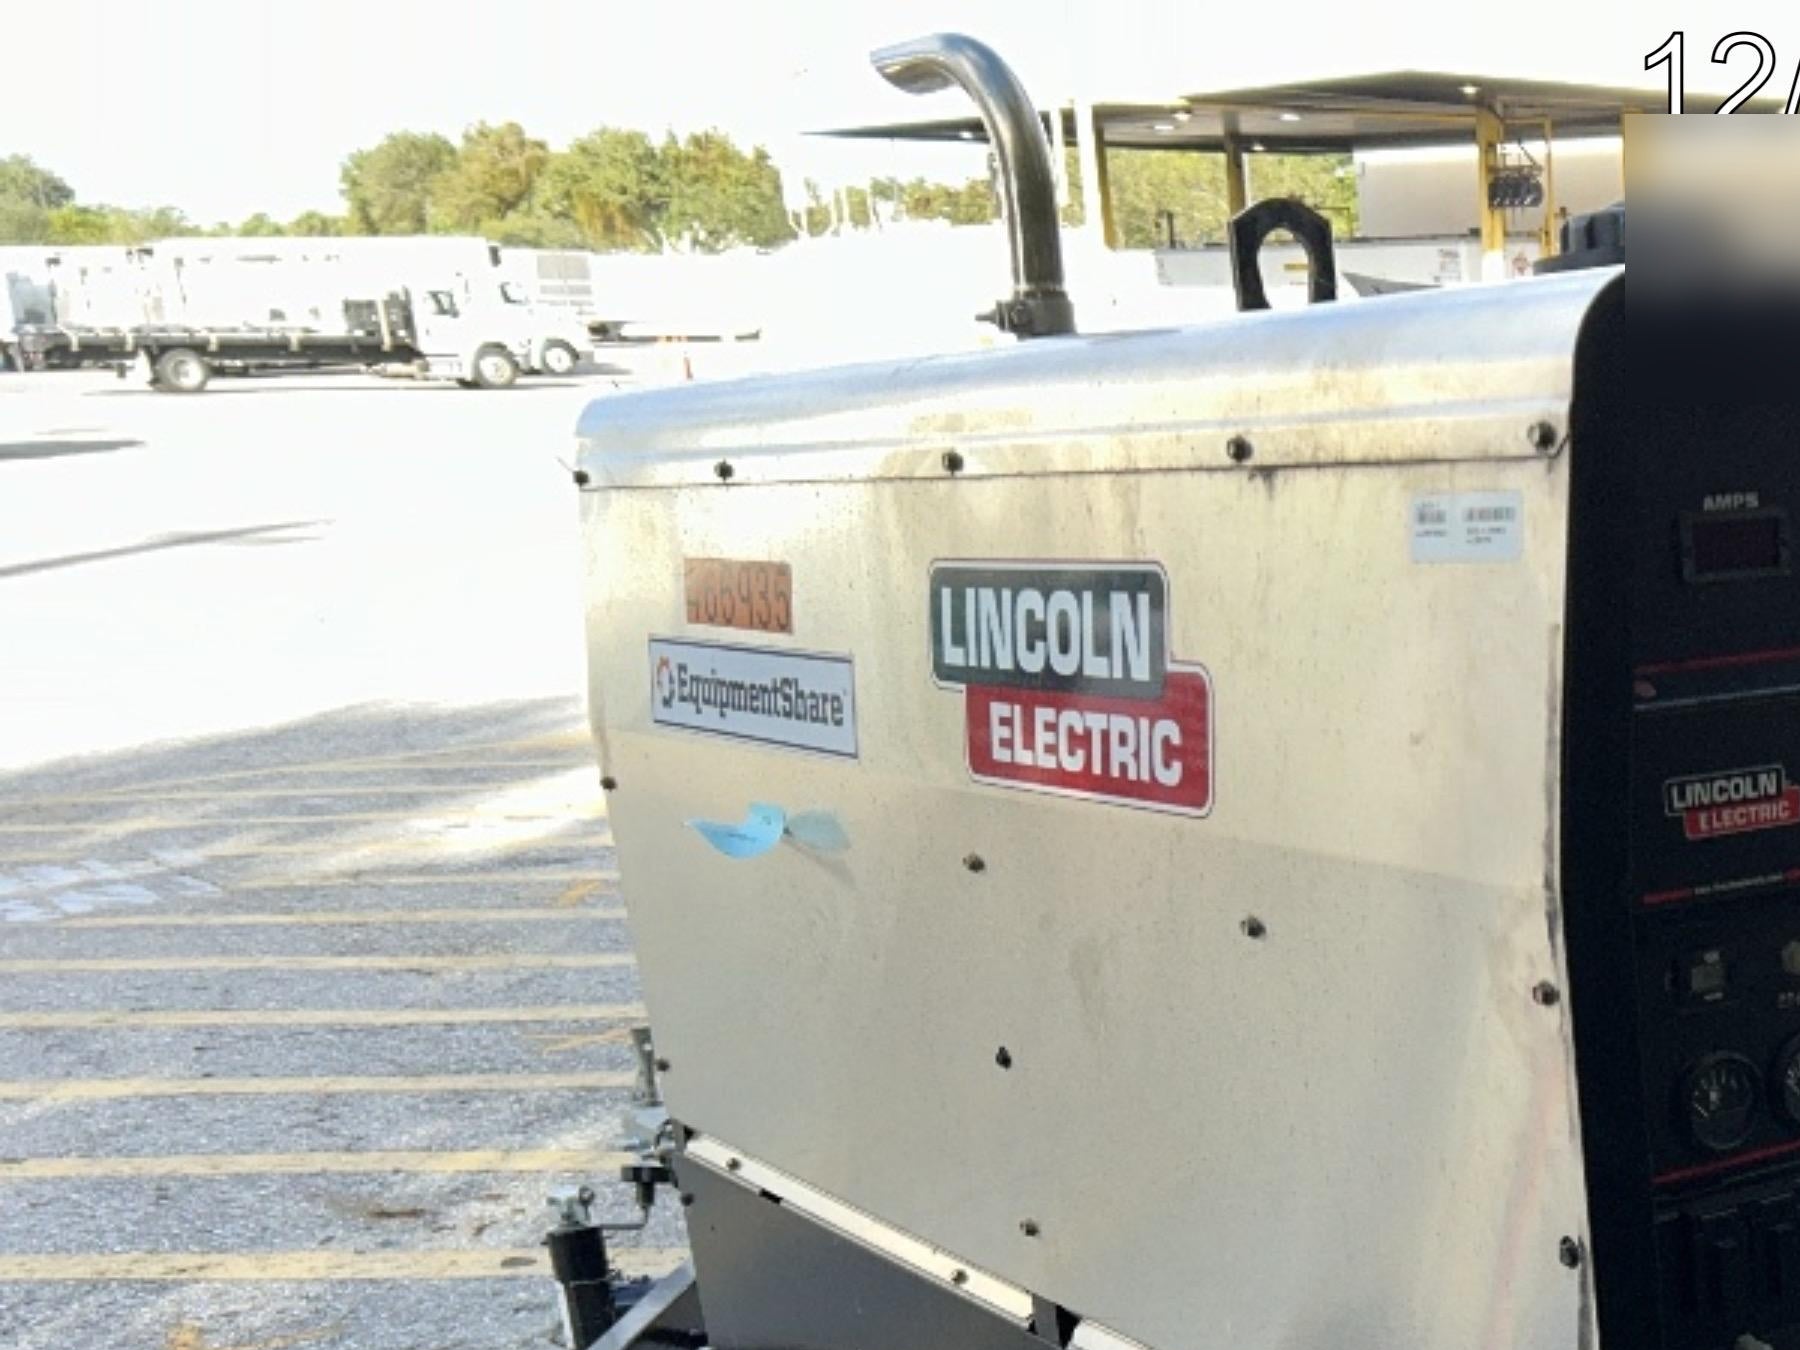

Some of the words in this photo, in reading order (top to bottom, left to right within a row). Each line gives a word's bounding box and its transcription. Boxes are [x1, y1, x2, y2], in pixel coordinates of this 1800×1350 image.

[1702, 490, 1760, 513] AMPS
[940, 586, 1151, 682] LINCOLN
[676, 662, 845, 727] EquipmentShare
[988, 700, 1183, 788] ELECTRIC
[1670, 770, 1778, 809] LINCOLN
[1698, 799, 1793, 833] ELECTRIC
